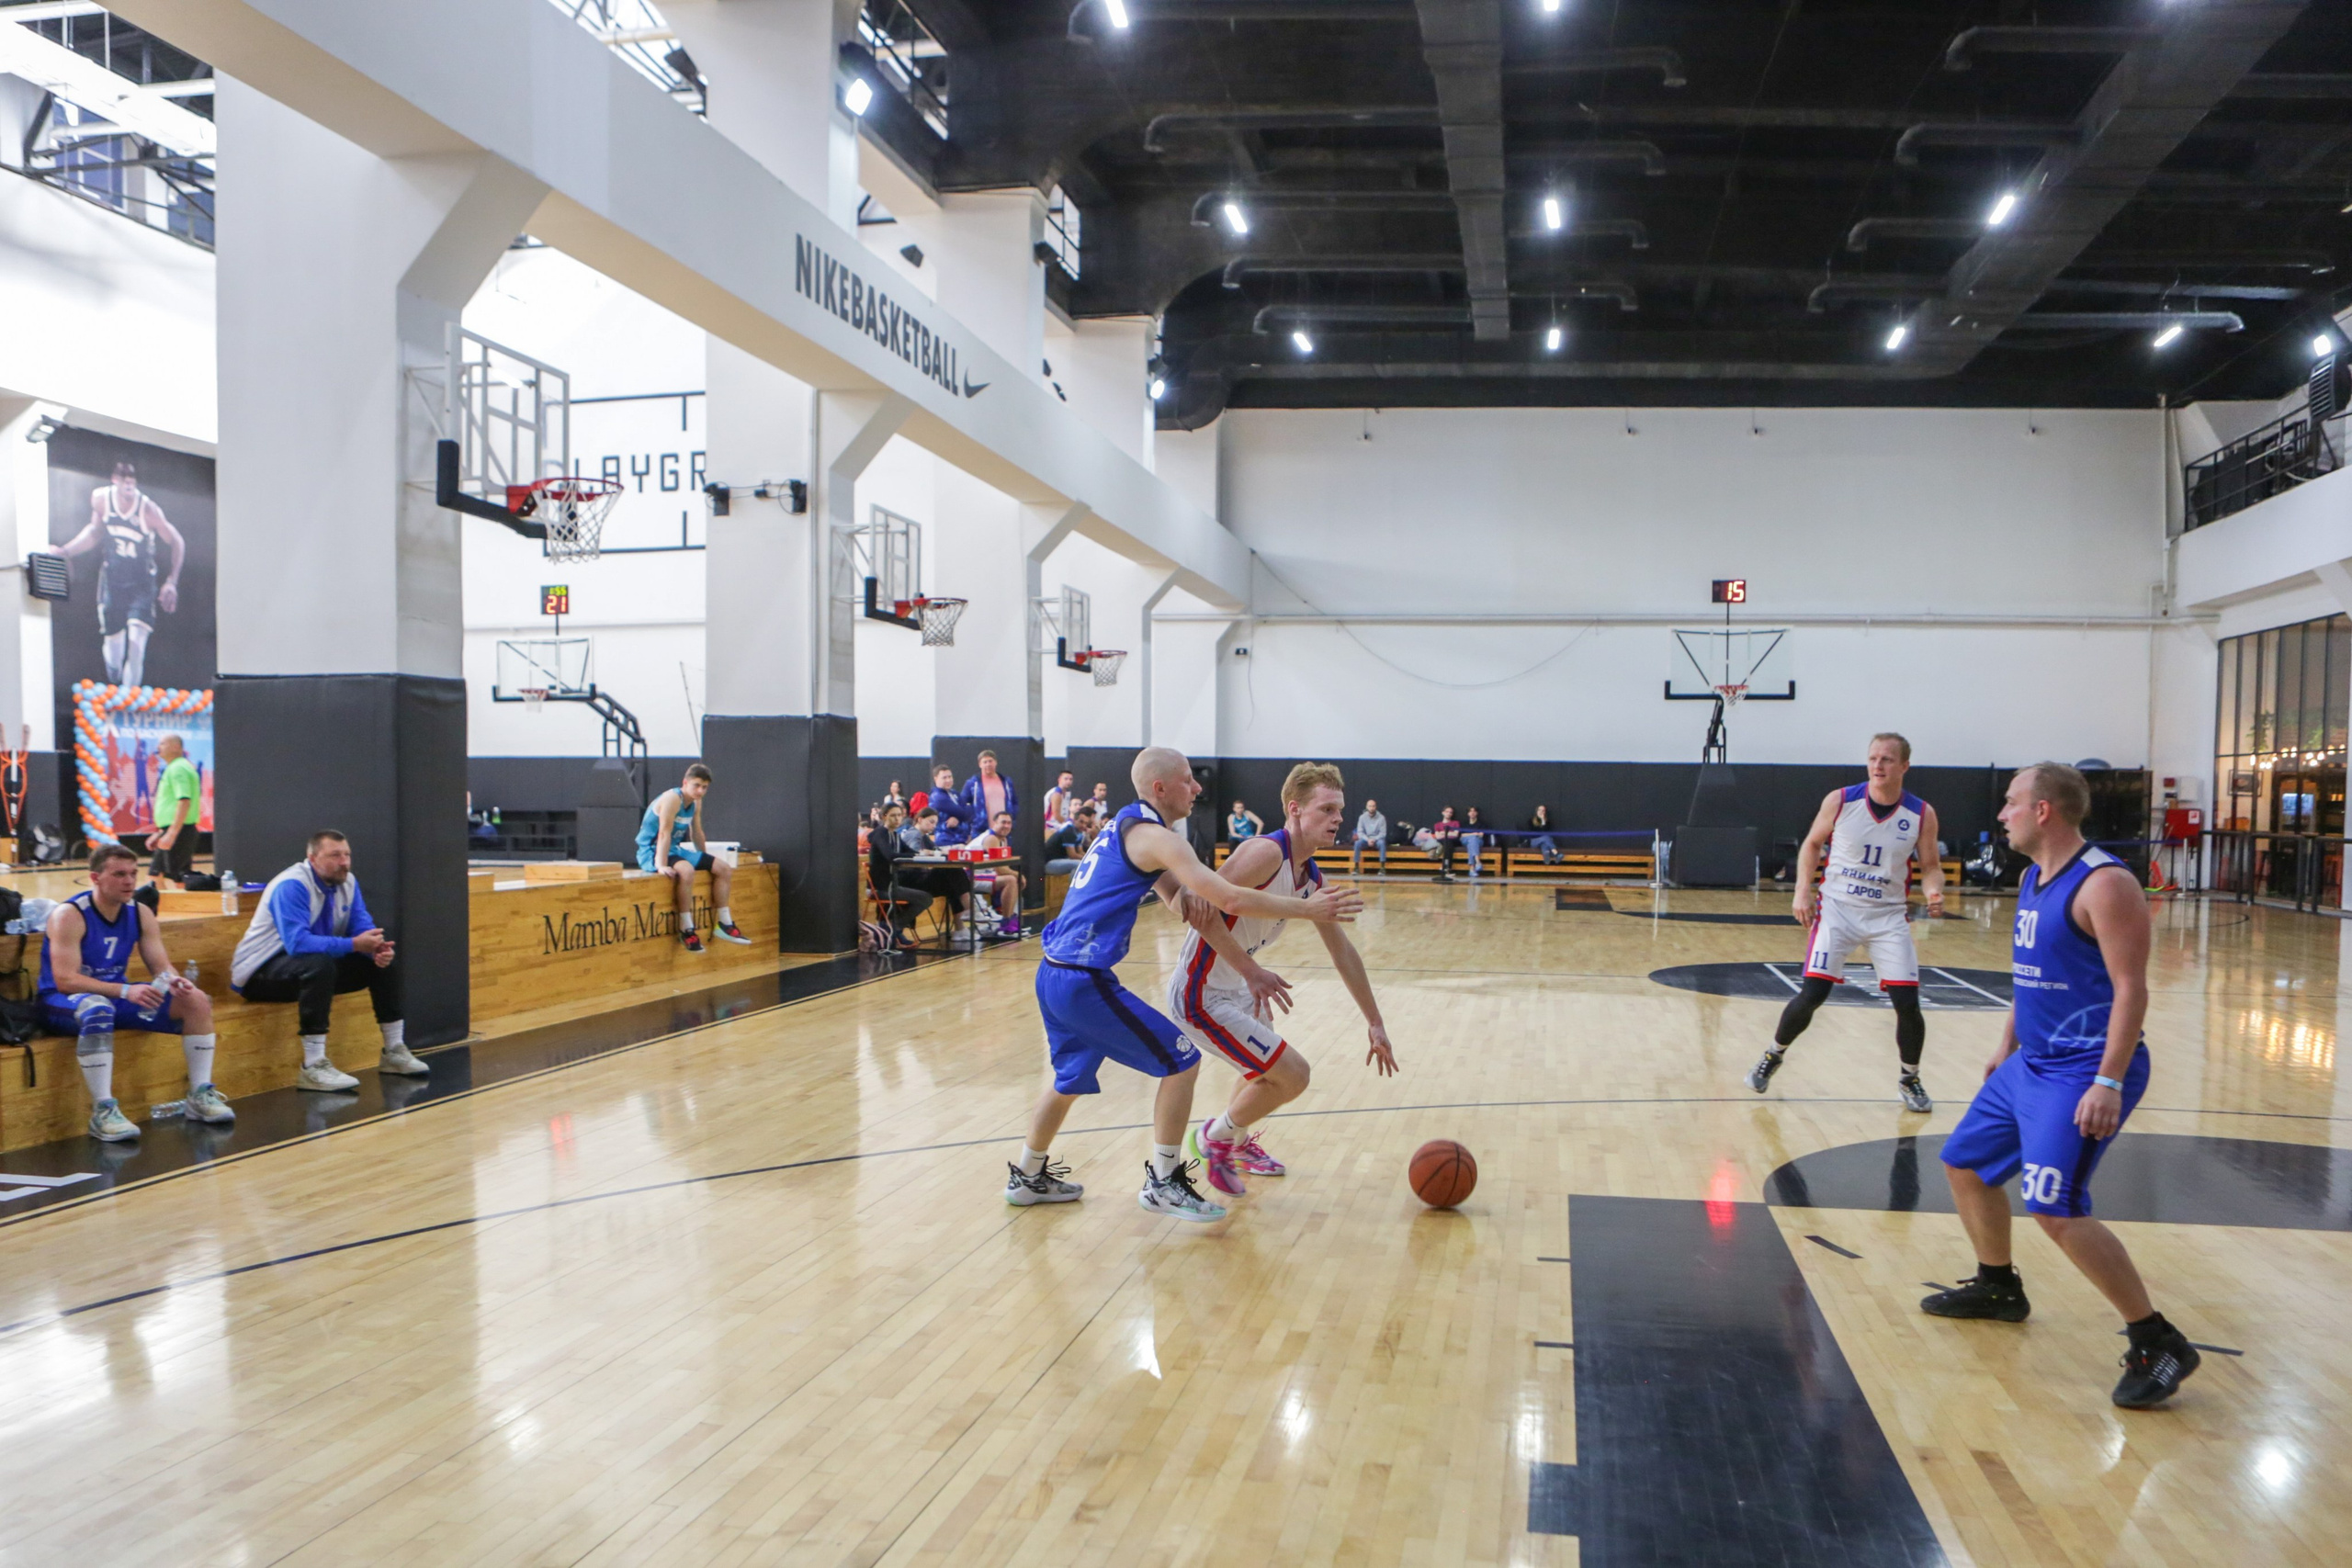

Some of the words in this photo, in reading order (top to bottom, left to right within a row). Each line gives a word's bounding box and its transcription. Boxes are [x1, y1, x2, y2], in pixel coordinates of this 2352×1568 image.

[796, 232, 958, 397] NIKEBASKETBALL
[1727, 581, 1745, 602] 15
[546, 594, 567, 614] 21
[1861, 844, 1883, 867] 11
[1847, 883, 1883, 899] САРОВ
[543, 906, 627, 954] Mamba
[633, 896, 716, 942] Menlity
[2014, 908, 2039, 949] 30
[104, 936, 119, 959] 7
[1812, 950, 1828, 970] 11
[1247, 1034, 1271, 1055] 1
[2020, 1162, 2063, 1204] 30
